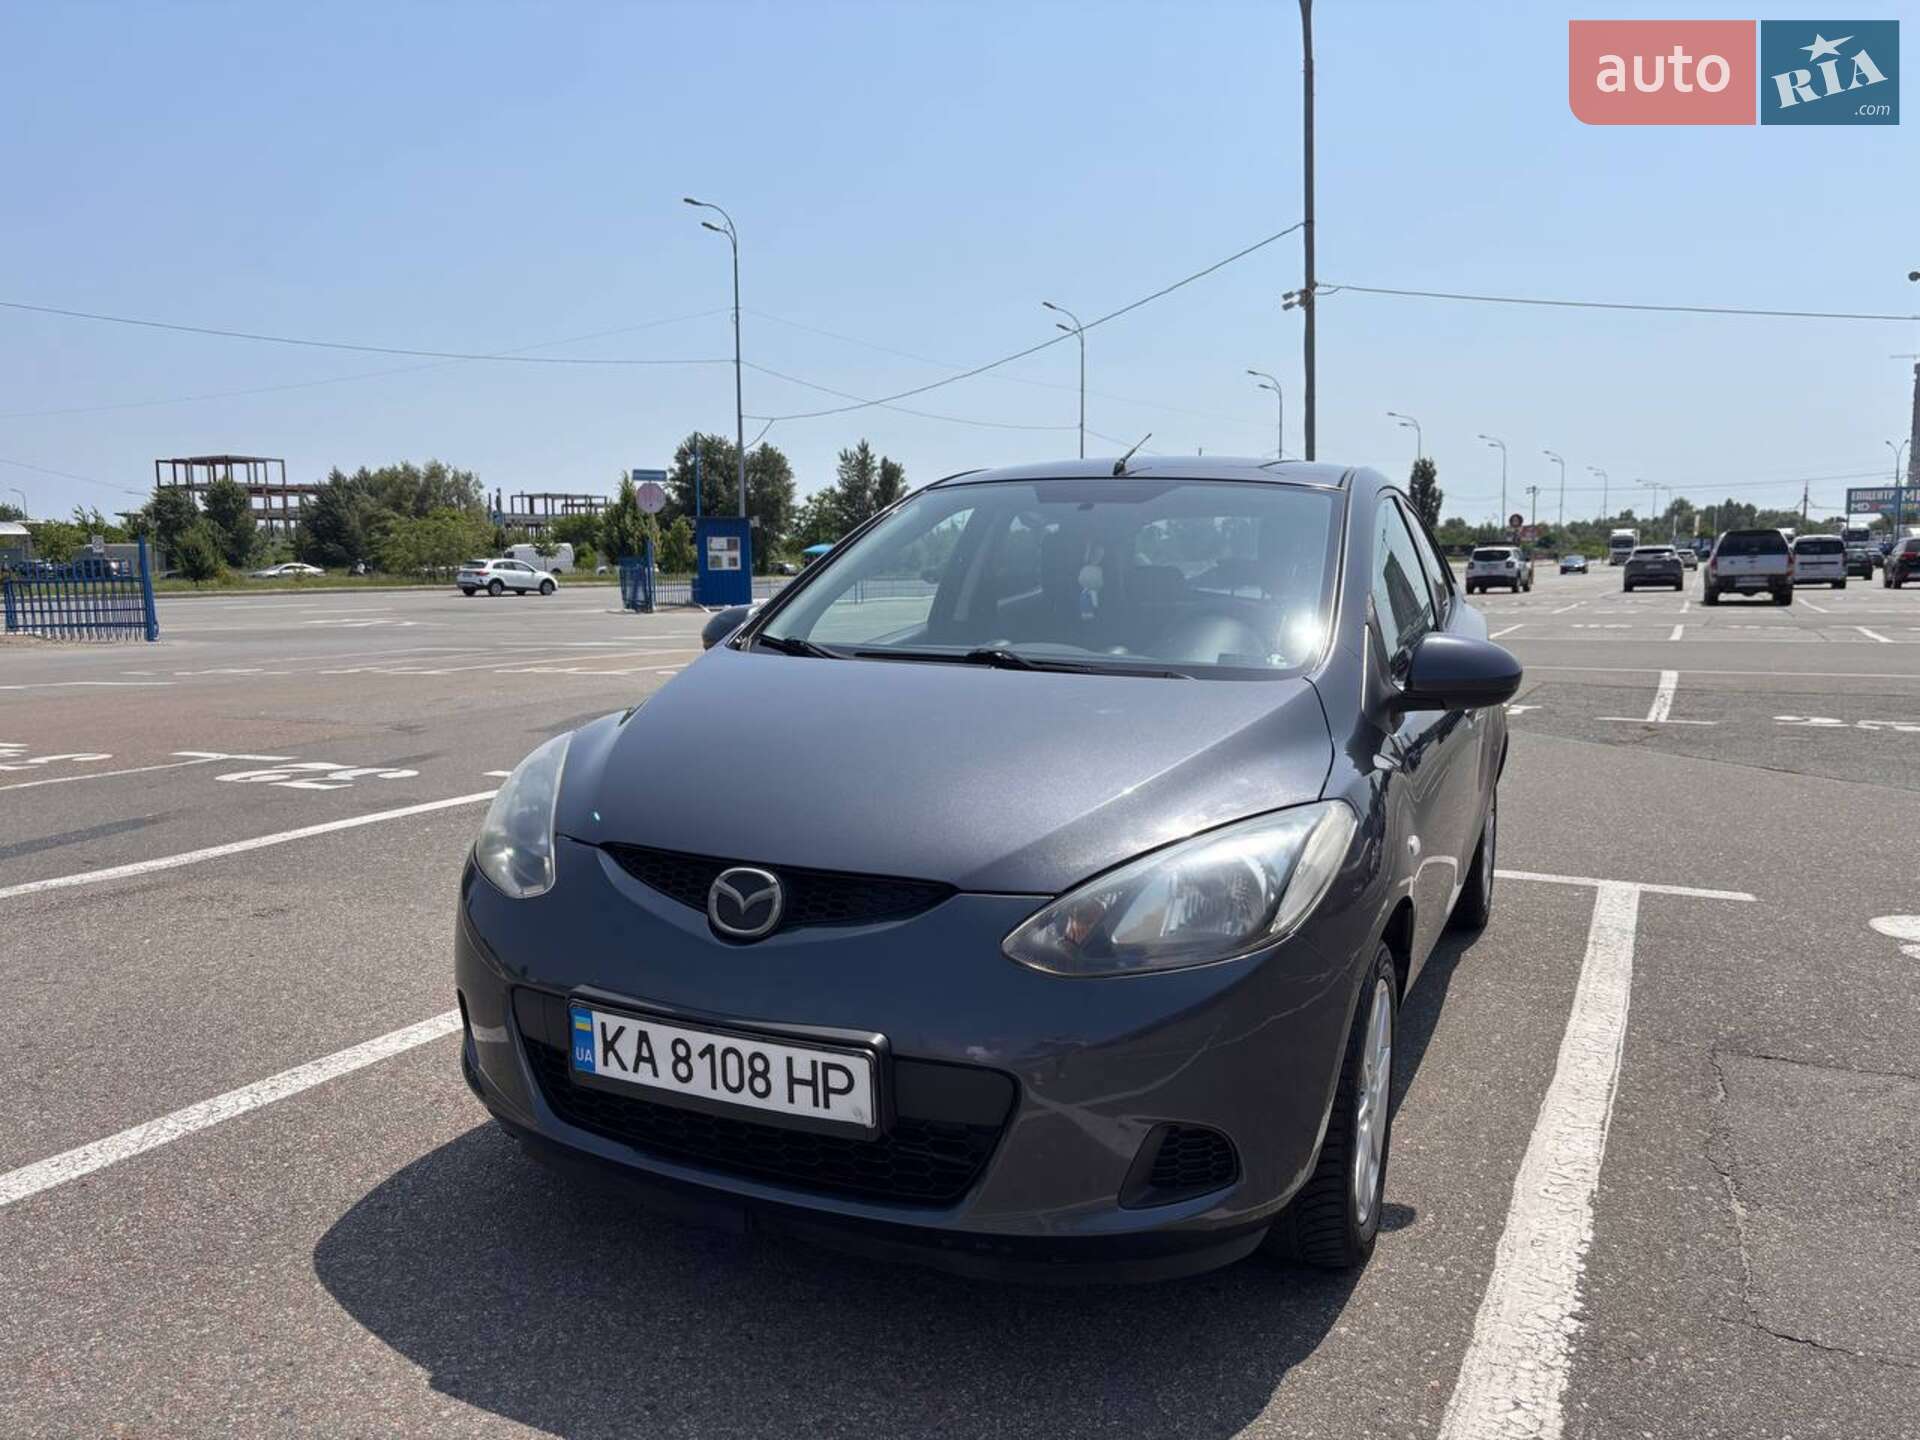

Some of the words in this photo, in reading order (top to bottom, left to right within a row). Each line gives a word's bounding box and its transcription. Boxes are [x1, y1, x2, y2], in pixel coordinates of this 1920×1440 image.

[575, 1046, 593, 1063] UA
[601, 1021, 659, 1079] KA
[670, 1037, 772, 1099] 8108
[786, 1056, 855, 1110] HP
